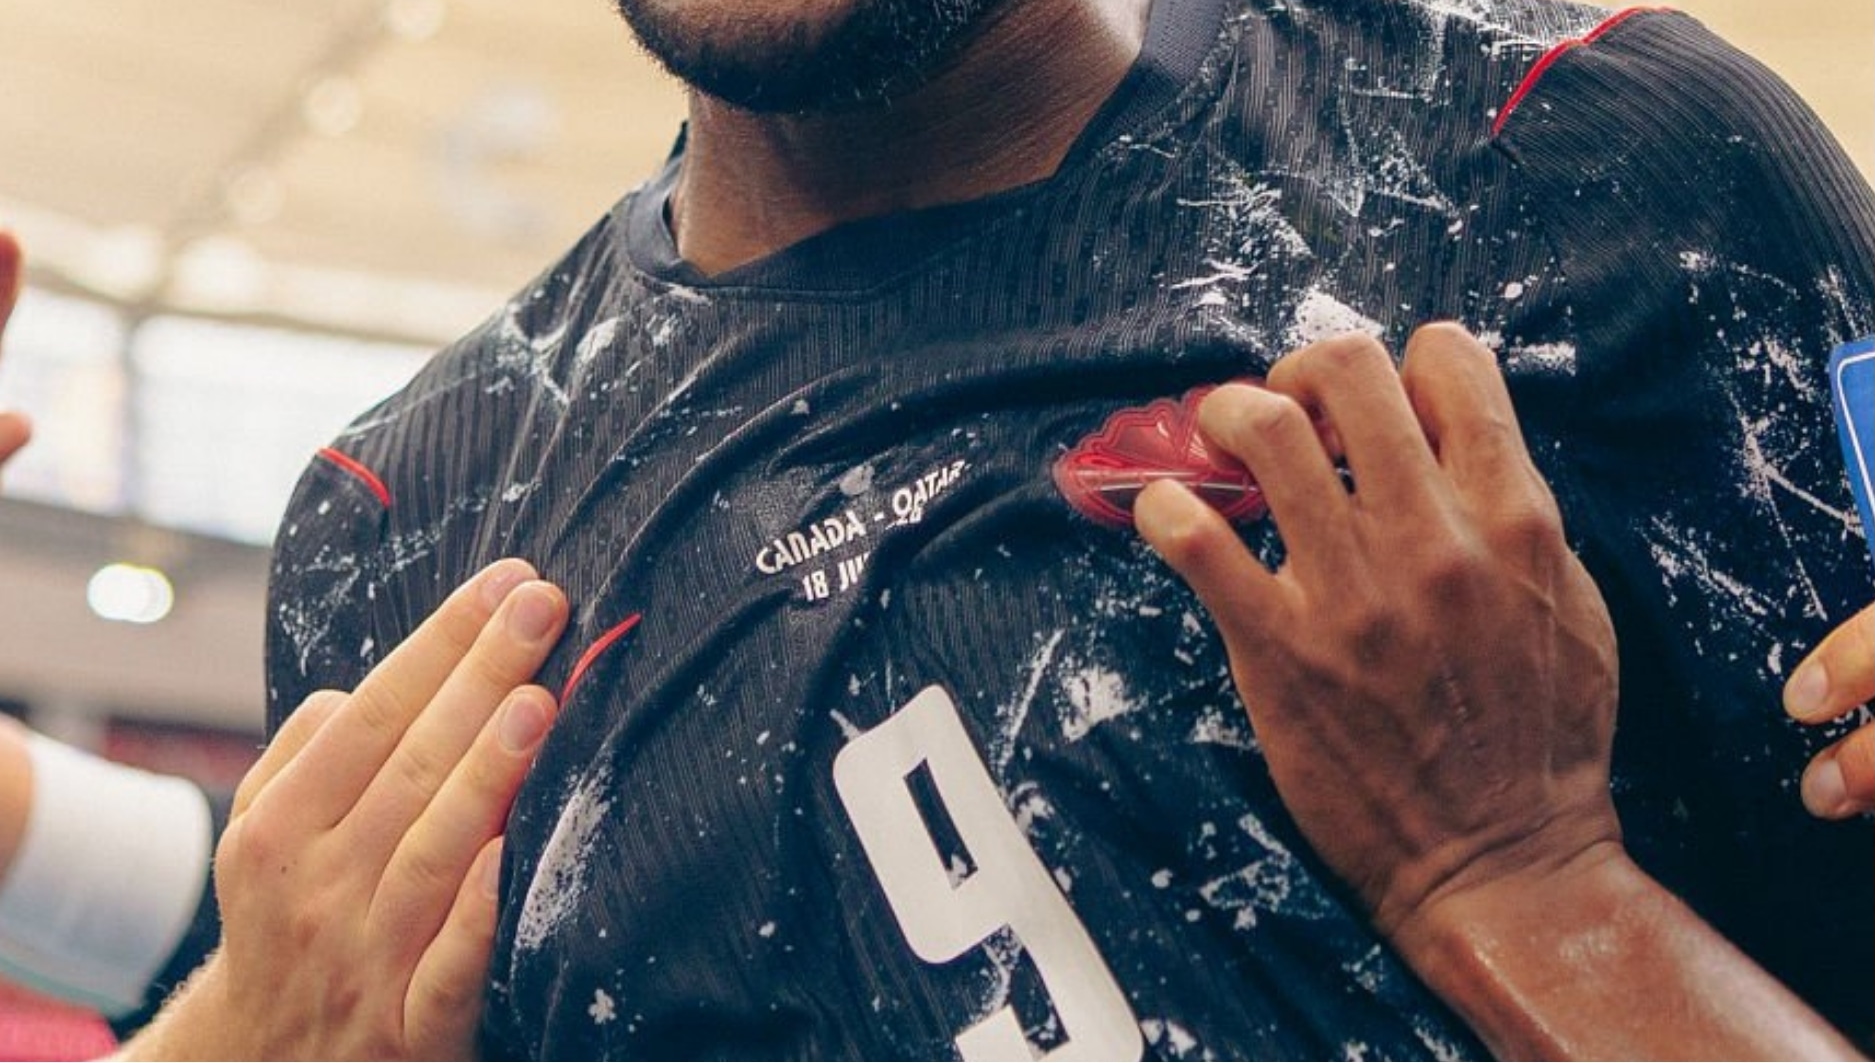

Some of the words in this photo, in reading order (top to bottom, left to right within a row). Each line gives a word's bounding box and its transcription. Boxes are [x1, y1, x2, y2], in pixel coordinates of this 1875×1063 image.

[756, 509, 867, 574] CANADA
[892, 459, 966, 517] QATAR
[802, 570, 829, 602] 18
[834, 684, 1145, 1060] 9
